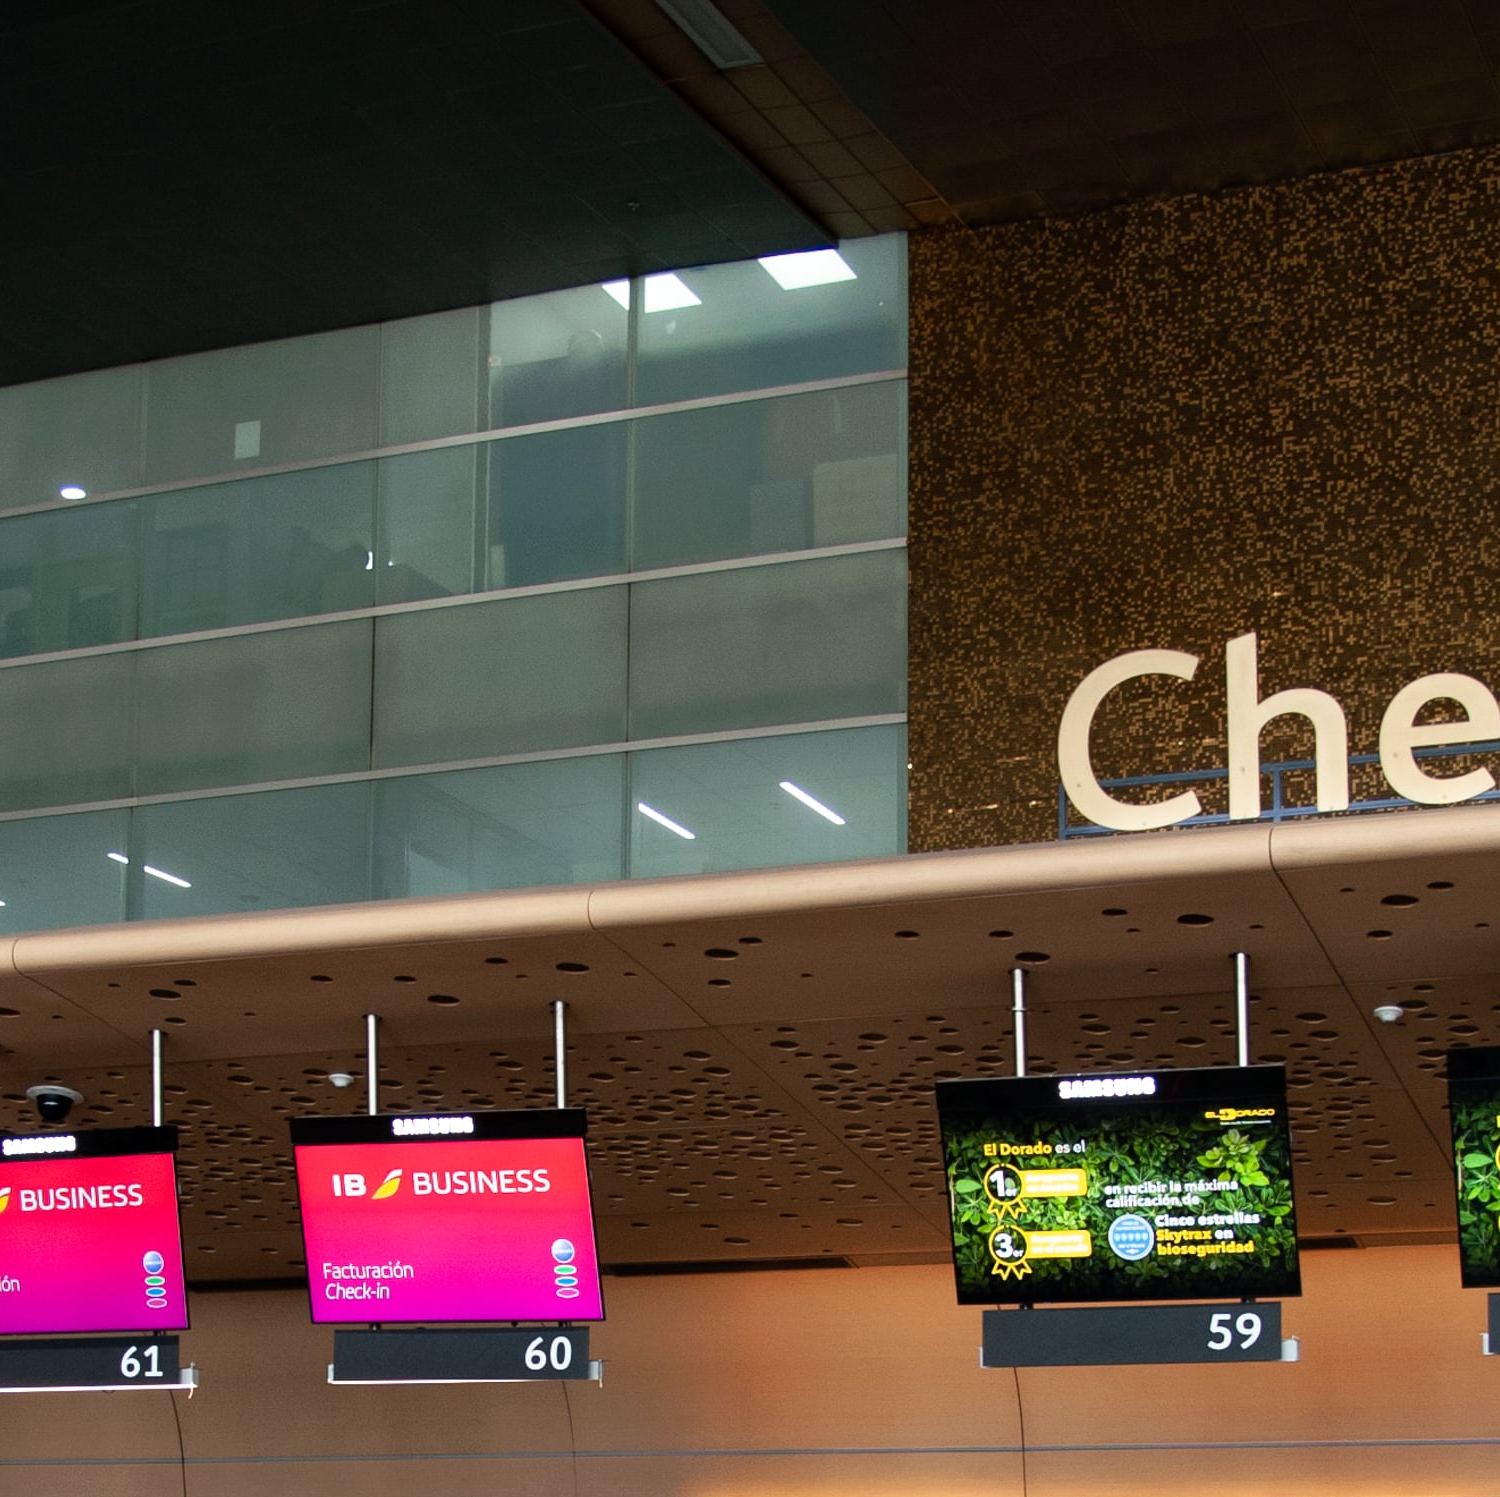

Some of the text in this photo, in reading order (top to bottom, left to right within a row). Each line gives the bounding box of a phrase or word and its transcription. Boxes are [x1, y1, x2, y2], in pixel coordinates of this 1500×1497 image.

[983, 1139, 1085, 1156] El Dorado es el
[332, 1170, 550, 1196] IB BUSINESS
[1104, 1179, 1238, 1195] en recibir la máxima
[20, 1185, 143, 1211] BUSINESS
[1105, 1193, 1200, 1208] calificación de
[1155, 1212, 1260, 1227] Cinco estrellas
[1156, 1229, 1212, 1243] Skytrax
[1214, 1229, 1234, 1239] en
[1157, 1240, 1254, 1257] bioseguridad
[323, 1261, 413, 1278] Facturación
[326, 1282, 390, 1300] Check-in
[1207, 1312, 1261, 1350] 59
[121, 1345, 163, 1378] 61
[525, 1336, 571, 1370] 60
